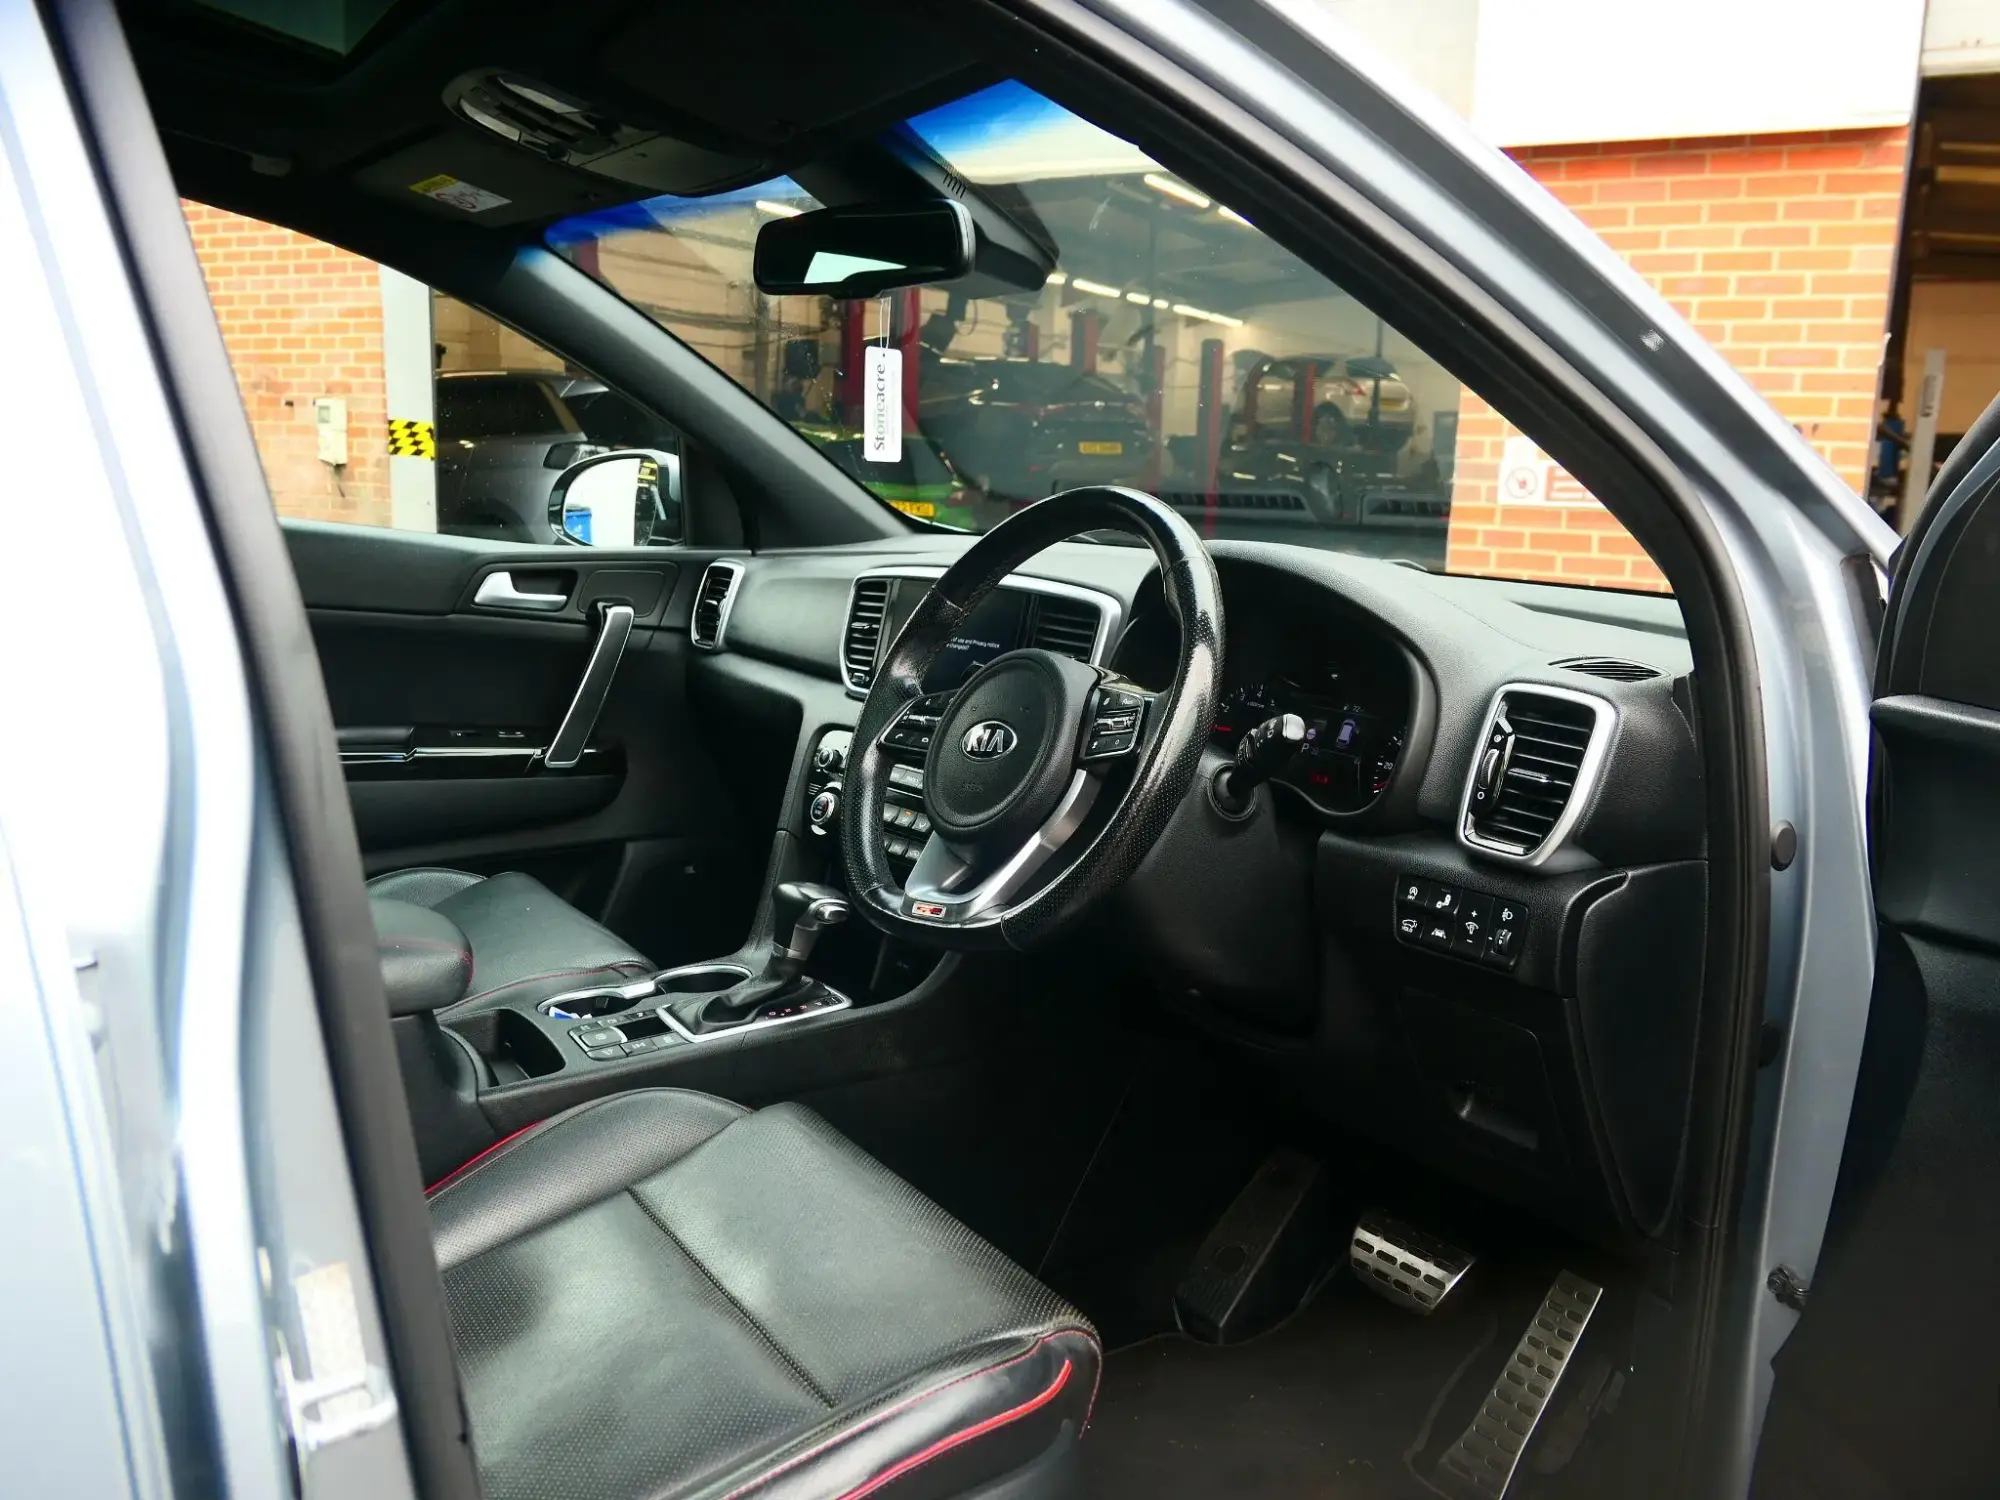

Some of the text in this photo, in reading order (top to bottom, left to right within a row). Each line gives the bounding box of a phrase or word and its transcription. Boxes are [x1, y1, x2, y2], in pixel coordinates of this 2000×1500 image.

[874, 363, 886, 451] Stoneacre
[967, 728, 1004, 753] KIA
[1301, 742, 1310, 753] P
